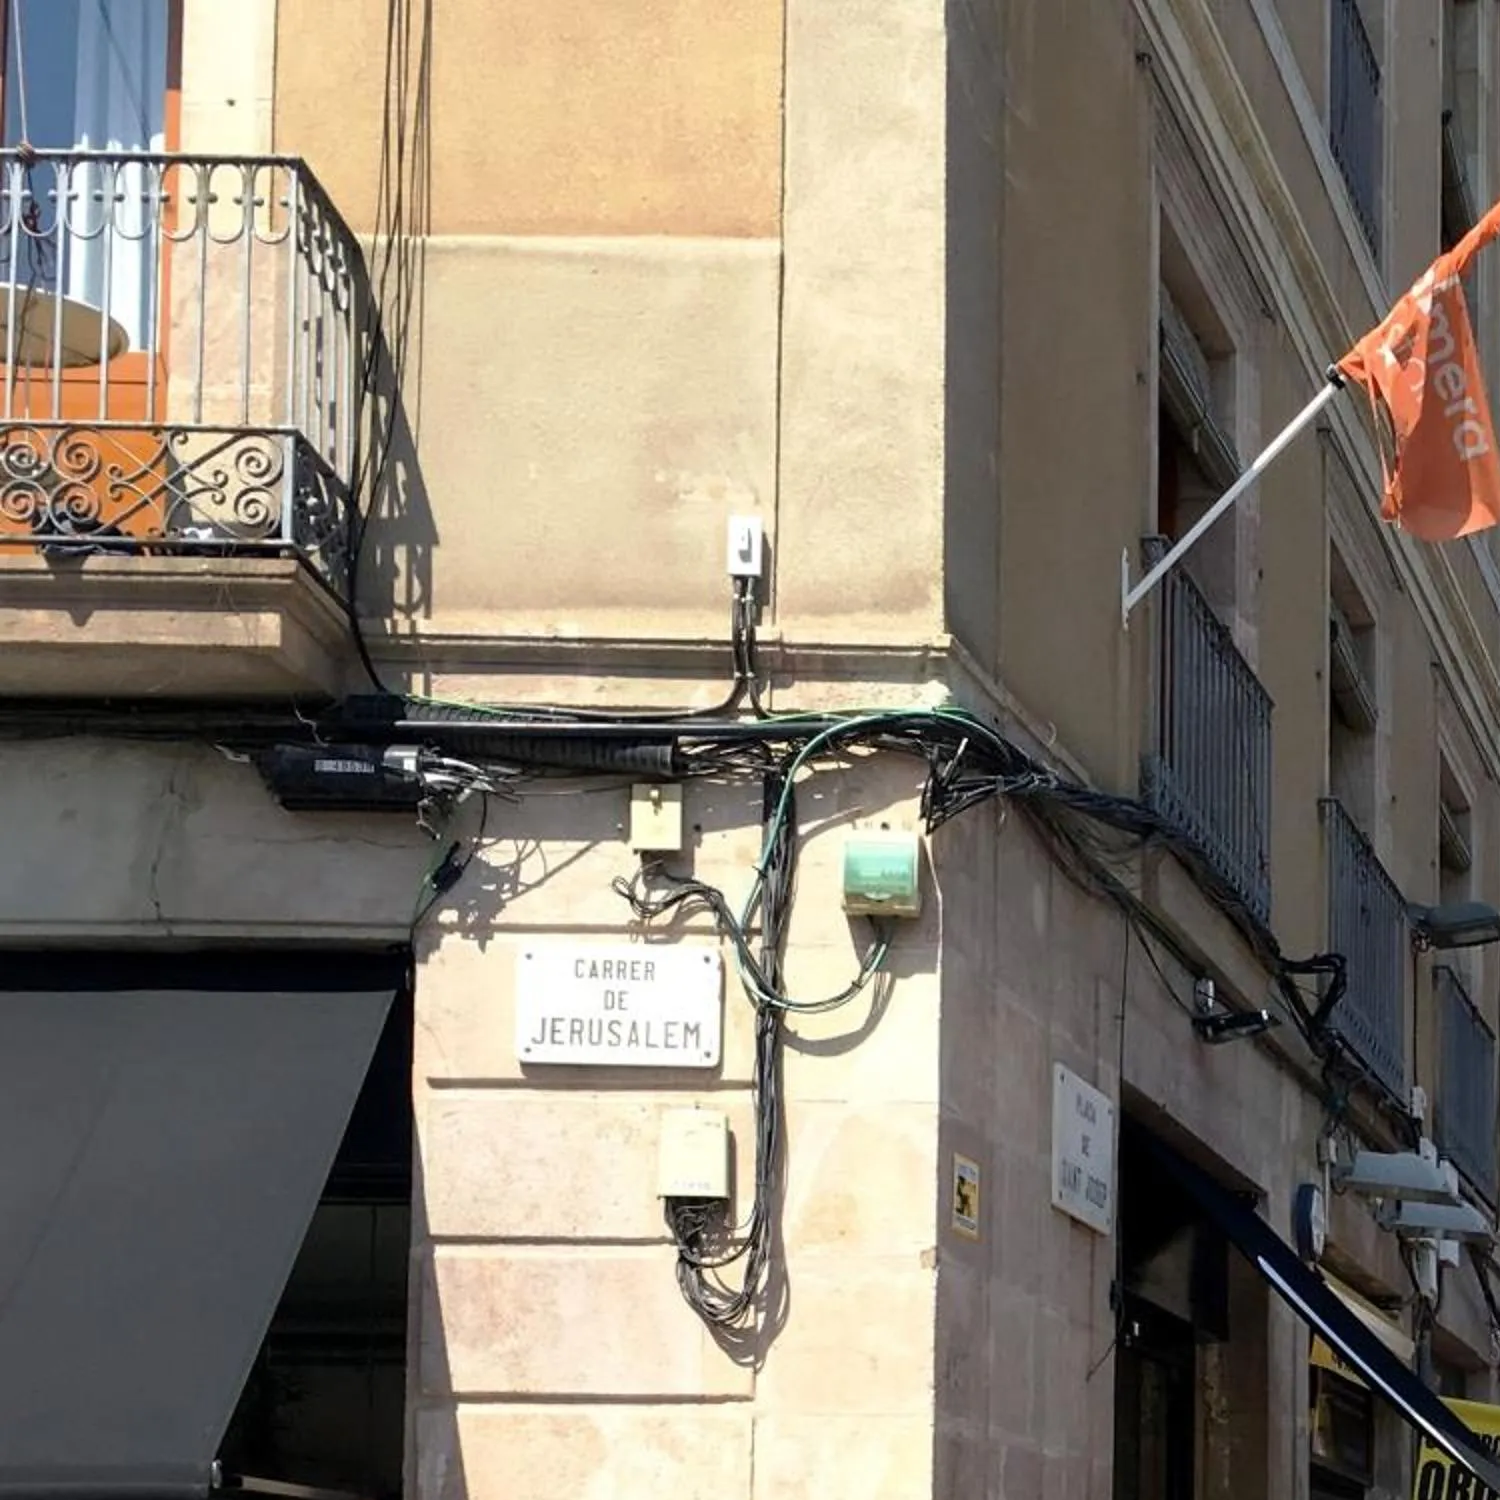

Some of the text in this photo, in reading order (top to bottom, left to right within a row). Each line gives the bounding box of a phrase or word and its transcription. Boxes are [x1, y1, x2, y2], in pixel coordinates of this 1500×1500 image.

[574, 958, 656, 982] CARRER
[603, 989, 629, 1012] DE
[531, 1016, 702, 1050] JERUSALEM
